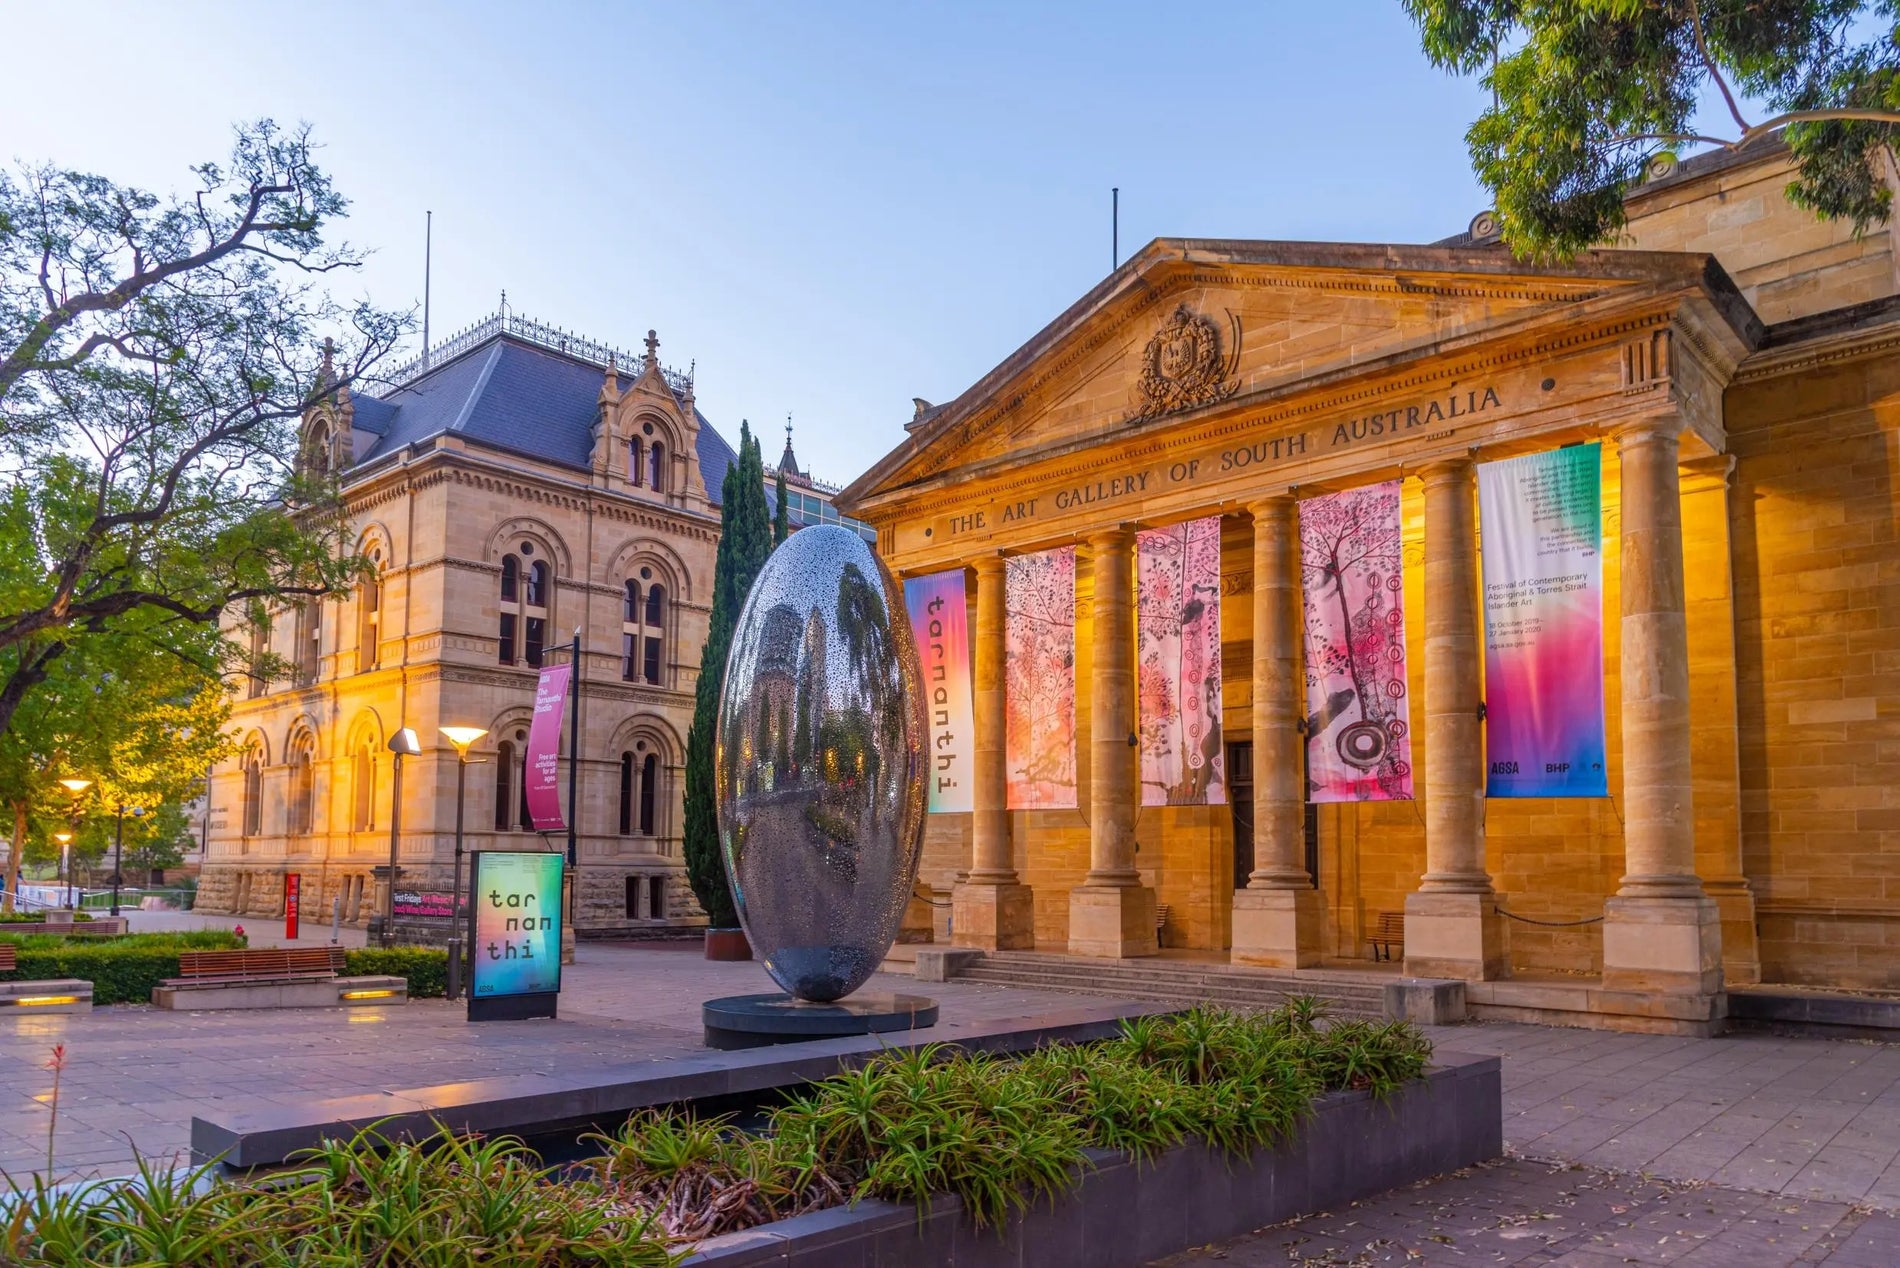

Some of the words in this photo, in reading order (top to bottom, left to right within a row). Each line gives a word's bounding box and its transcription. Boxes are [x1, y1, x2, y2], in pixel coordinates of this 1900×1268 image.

[950, 512, 986, 534] THE
[1003, 498, 1038, 523] ART
[1056, 471, 1149, 510] GALLERY
[1169, 459, 1200, 482] OF
[1221, 433, 1307, 471] SOUTH
[1331, 387, 1502, 446] AUSTRALIA
[1487, 581, 1516, 592] Festival
[1528, 572, 1588, 586] Contemporary
[1487, 589, 1527, 601] Aboriginal
[1537, 586, 1562, 595] Torres
[1565, 582, 1587, 592] Strait
[1488, 600, 1518, 610] Islander
[1521, 598, 1532, 606] Art
[1497, 620, 1522, 629] October
[1498, 627, 1524, 637] January
[927, 595, 957, 794] tarnanthi
[1491, 761, 1519, 774] AGSA
[1546, 763, 1570, 773] BHP
[489, 889, 535, 908] tar
[506, 917, 551, 931] nan
[487, 939, 534, 960] thi
